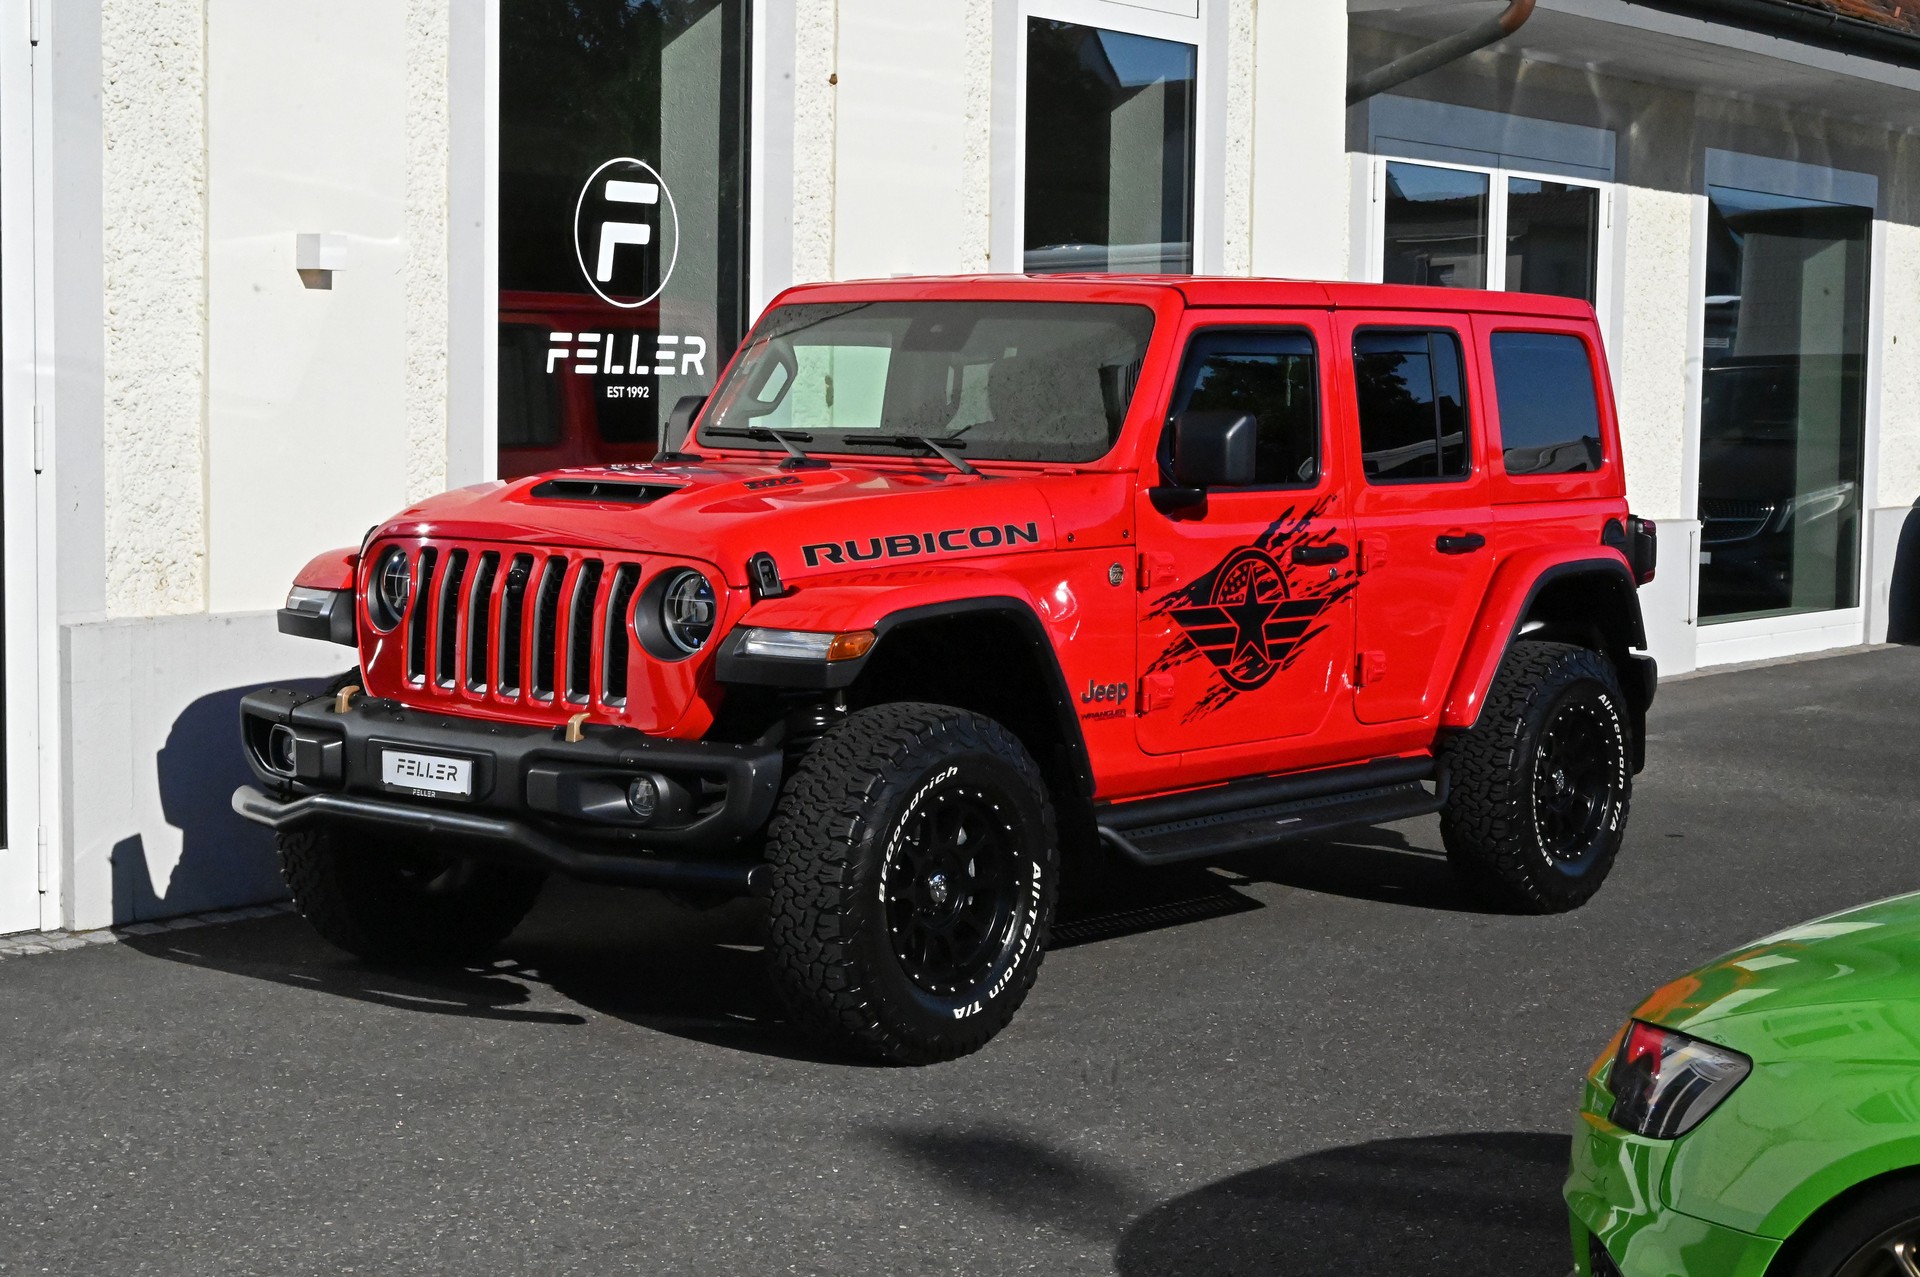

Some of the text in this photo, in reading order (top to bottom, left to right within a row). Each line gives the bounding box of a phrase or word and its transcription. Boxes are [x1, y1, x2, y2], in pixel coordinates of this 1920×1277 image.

[596, 179, 659, 282] F
[546, 332, 707, 376] FELLER
[606, 386, 650, 398] EST 1992
[800, 522, 1040, 568] RUBICON
[1080, 679, 1129, 705] Jeep
[396, 758, 458, 781] FELLER
[412, 788, 436, 798] FELLER
[1609, 801, 1623, 831] T/A
[878, 766, 959, 904] BFGoodrich
[952, 861, 1042, 1020] All-Terrain T/A
